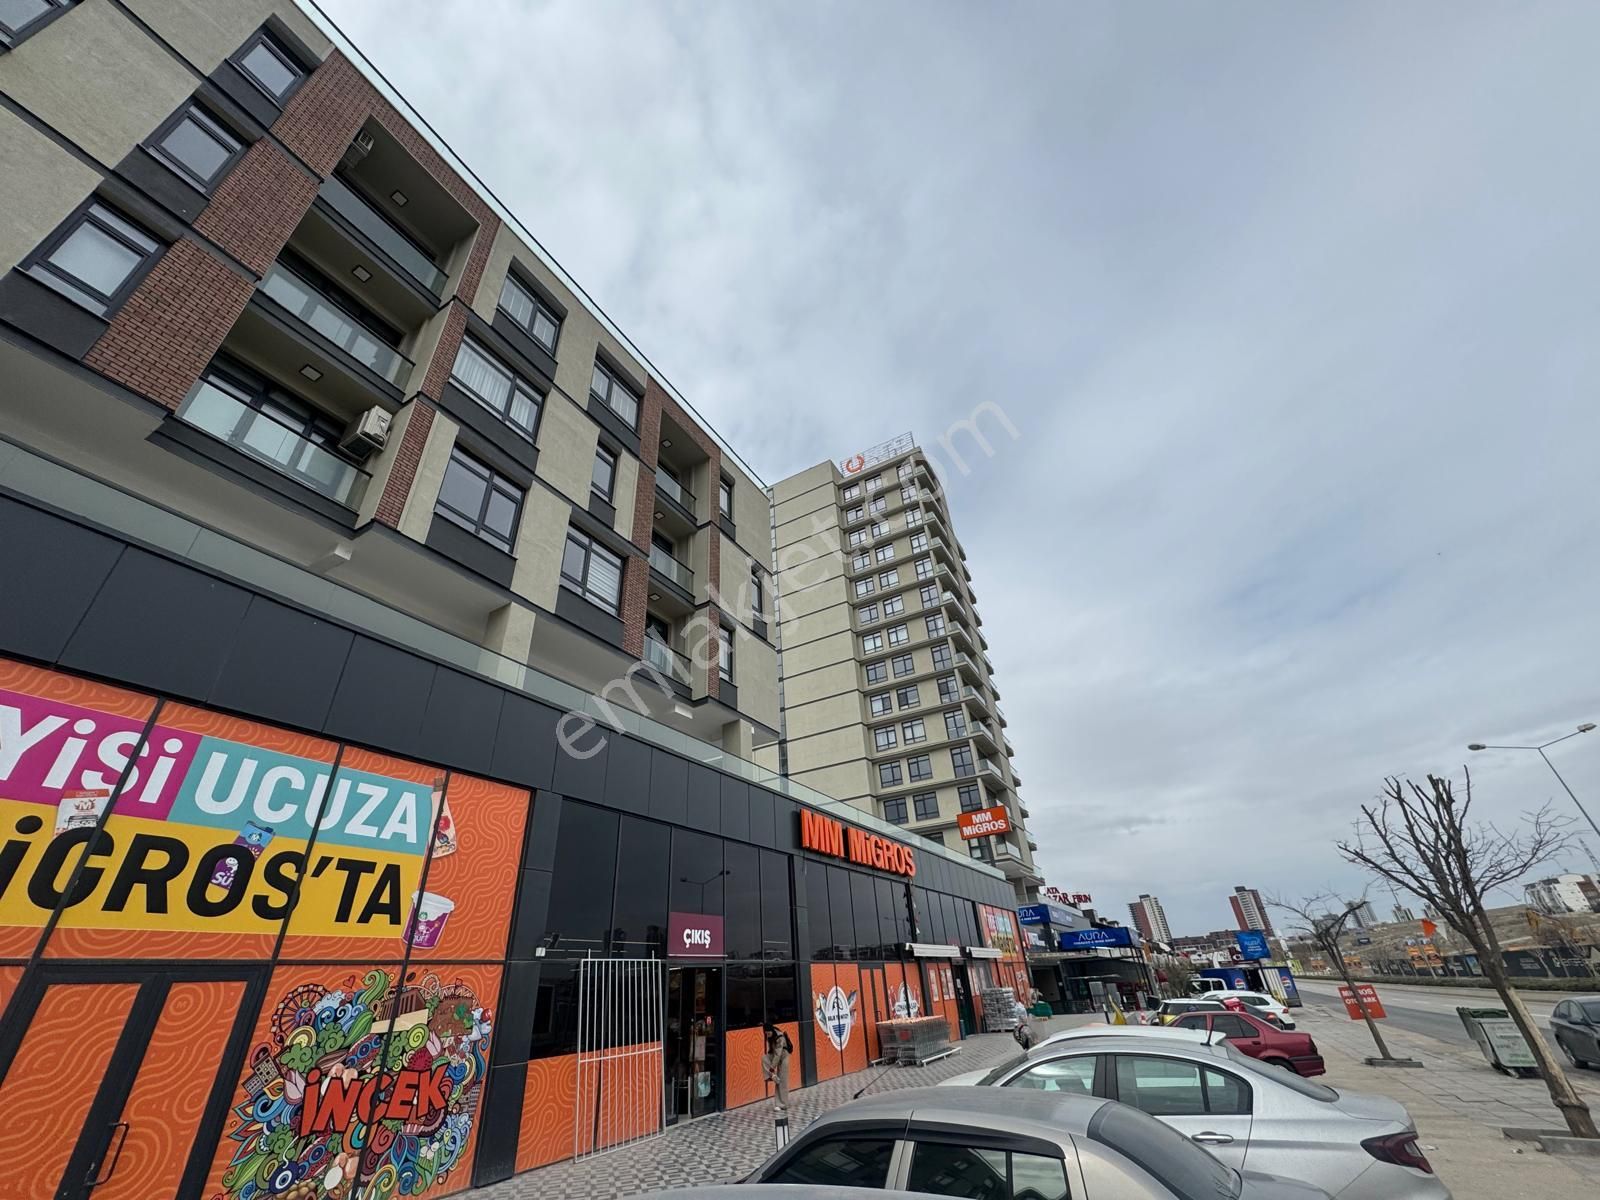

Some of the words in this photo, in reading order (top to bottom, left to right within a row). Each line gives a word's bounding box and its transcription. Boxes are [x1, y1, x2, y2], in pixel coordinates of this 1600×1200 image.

[195, 752, 418, 843] UCUZA
[801, 808, 844, 858] MM
[972, 812, 992, 824] MM
[683, 928, 711, 948] ÇIKIŞ
